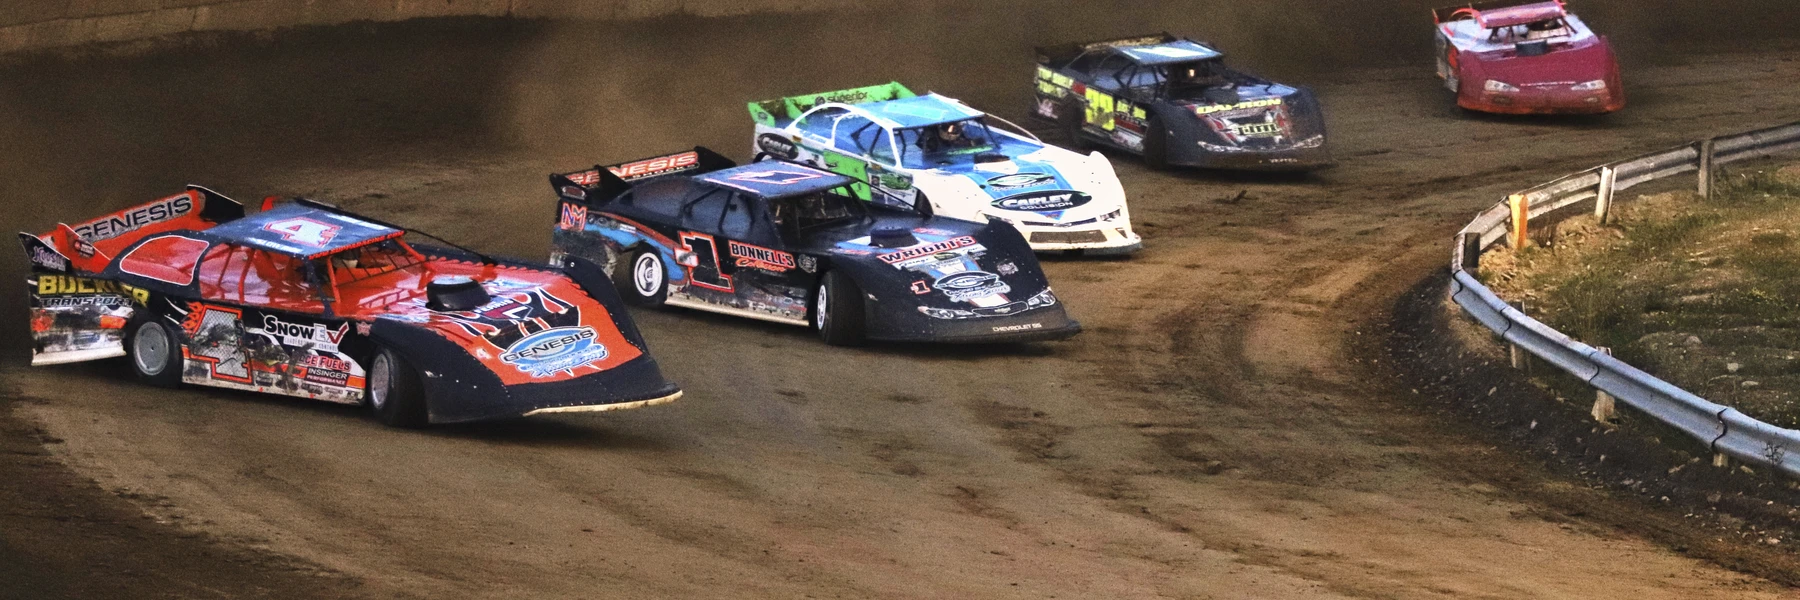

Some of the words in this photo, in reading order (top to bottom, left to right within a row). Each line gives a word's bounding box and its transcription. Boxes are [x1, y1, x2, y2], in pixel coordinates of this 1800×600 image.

[1002, 193, 1073, 208] CARLEY
[1019, 201, 1074, 210] COLLISION
[74, 196, 193, 240] GENESIS
[731, 243, 794, 267] BONNELL'S
[881, 236, 974, 263] WRIGHT'S
[678, 231, 735, 293] 1
[993, 324, 1031, 332] CHEVROLET
[503, 328, 595, 362] GENESIS
[319, 356, 351, 371] FUELS
[308, 368, 347, 379] INSINGER
